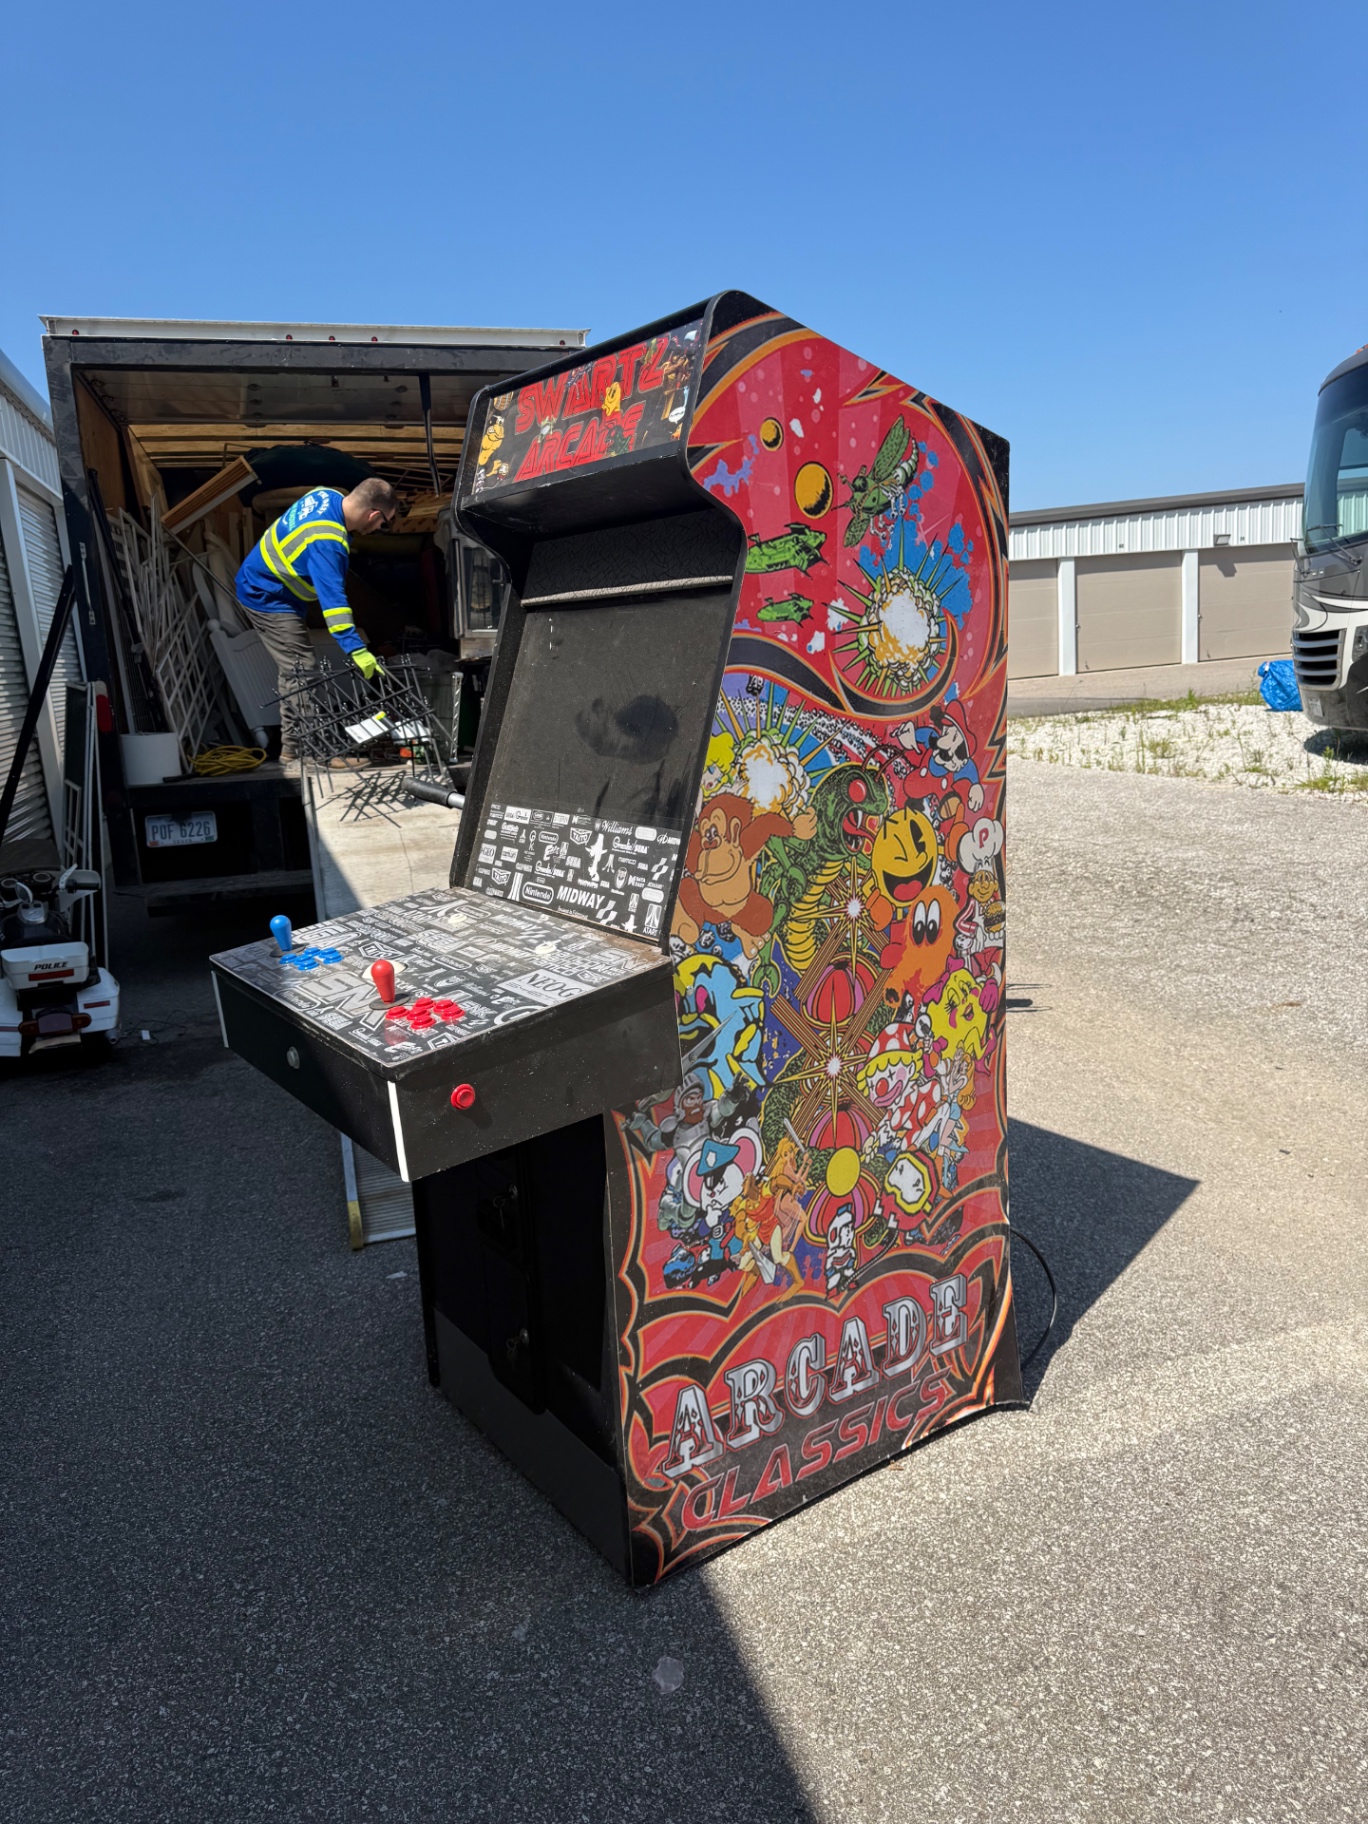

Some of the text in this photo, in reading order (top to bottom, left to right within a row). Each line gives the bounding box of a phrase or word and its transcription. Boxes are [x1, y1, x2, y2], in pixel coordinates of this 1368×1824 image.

[514, 336, 670, 435] SWARTZ
[513, 400, 647, 484] ARCADE
[180, 820, 211, 838] 6226
[601, 819, 632, 835] Williams
[573, 832, 587, 842] TAITO
[525, 887, 551, 900] Nintendo
[557, 885, 605, 909] MIDWAY
[364, 945, 394, 958] TAITO
[33, 960, 68, 971] POLICE
[281, 990, 313, 1009] Nintendo
[458, 1001, 498, 1019] SNK
[661, 1273, 969, 1478] ARCADE
[680, 1364, 955, 1532] CLASSICS
